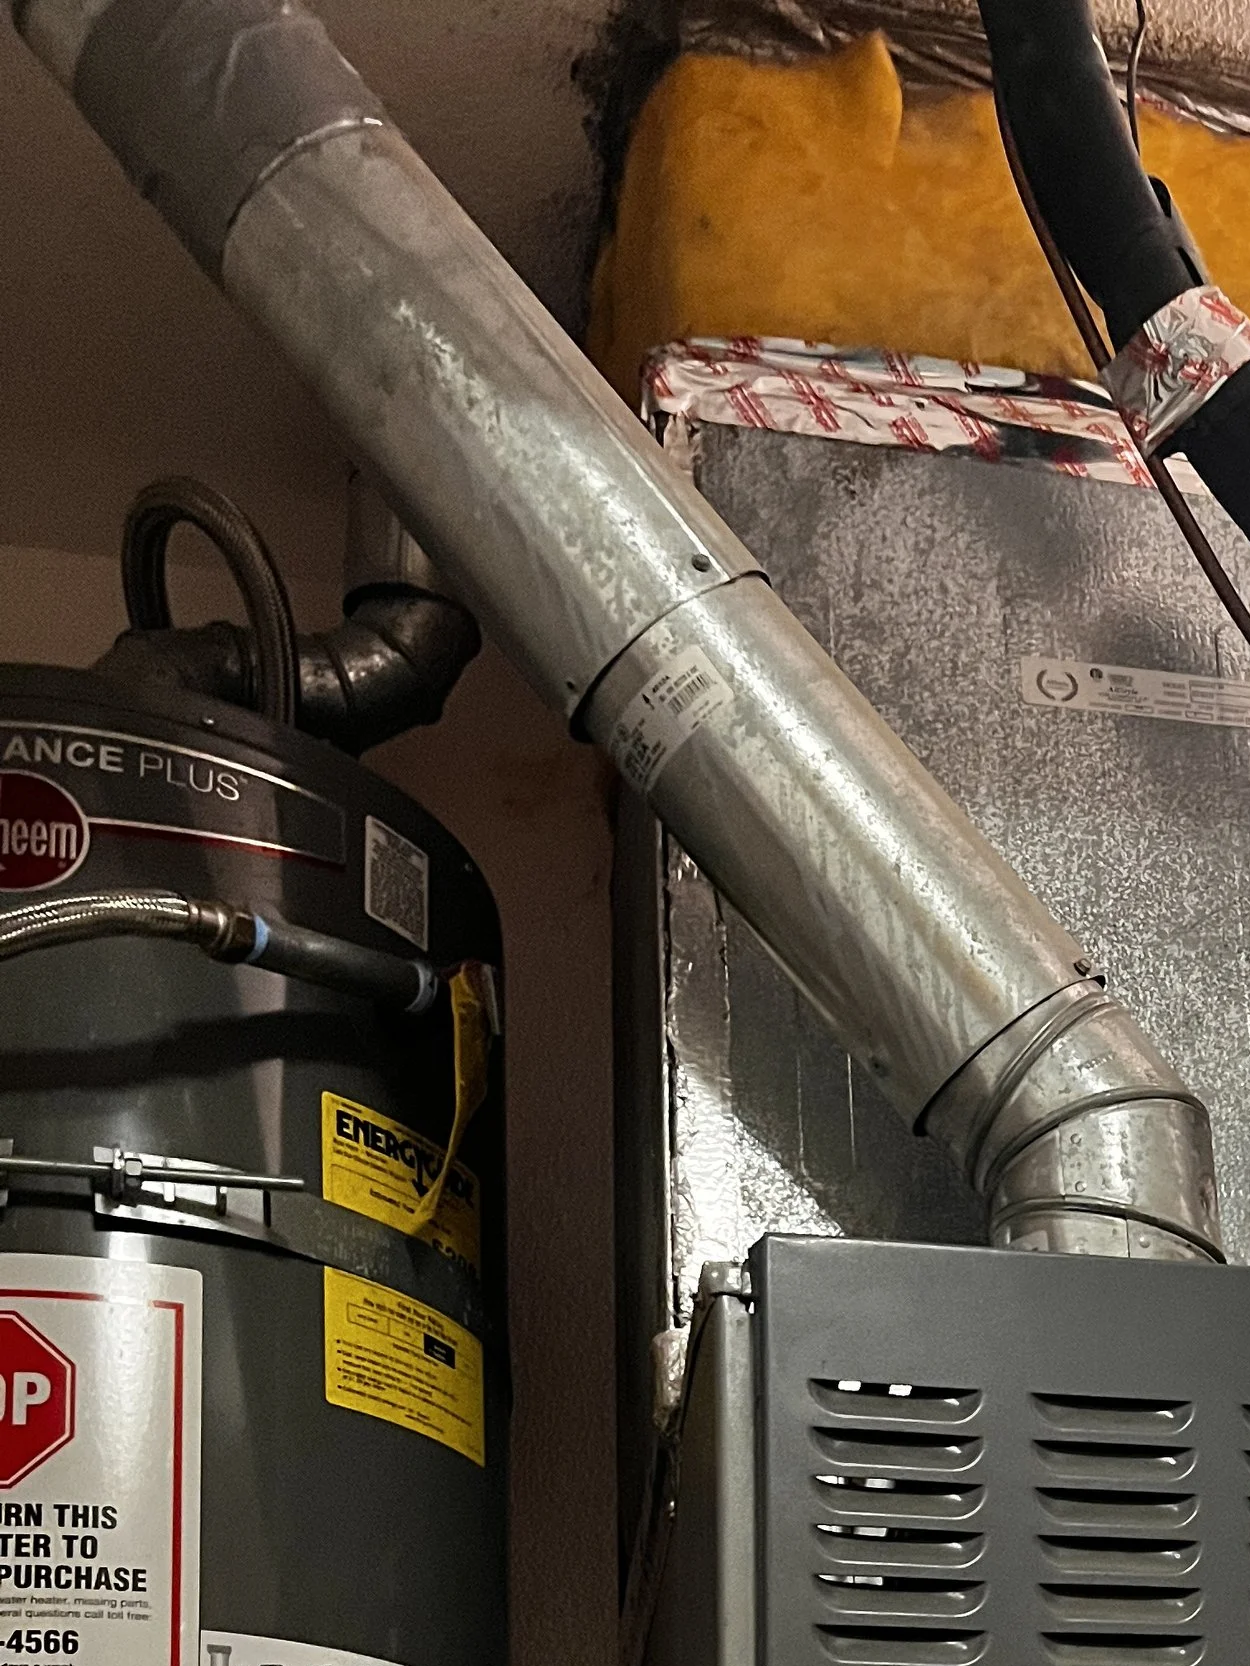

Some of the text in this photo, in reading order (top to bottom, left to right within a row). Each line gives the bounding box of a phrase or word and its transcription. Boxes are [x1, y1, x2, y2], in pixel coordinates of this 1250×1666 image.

[2, 735, 124, 773] ANCE
[53, 1504, 118, 1530] THIS
[62, 1535, 98, 1559] TO
